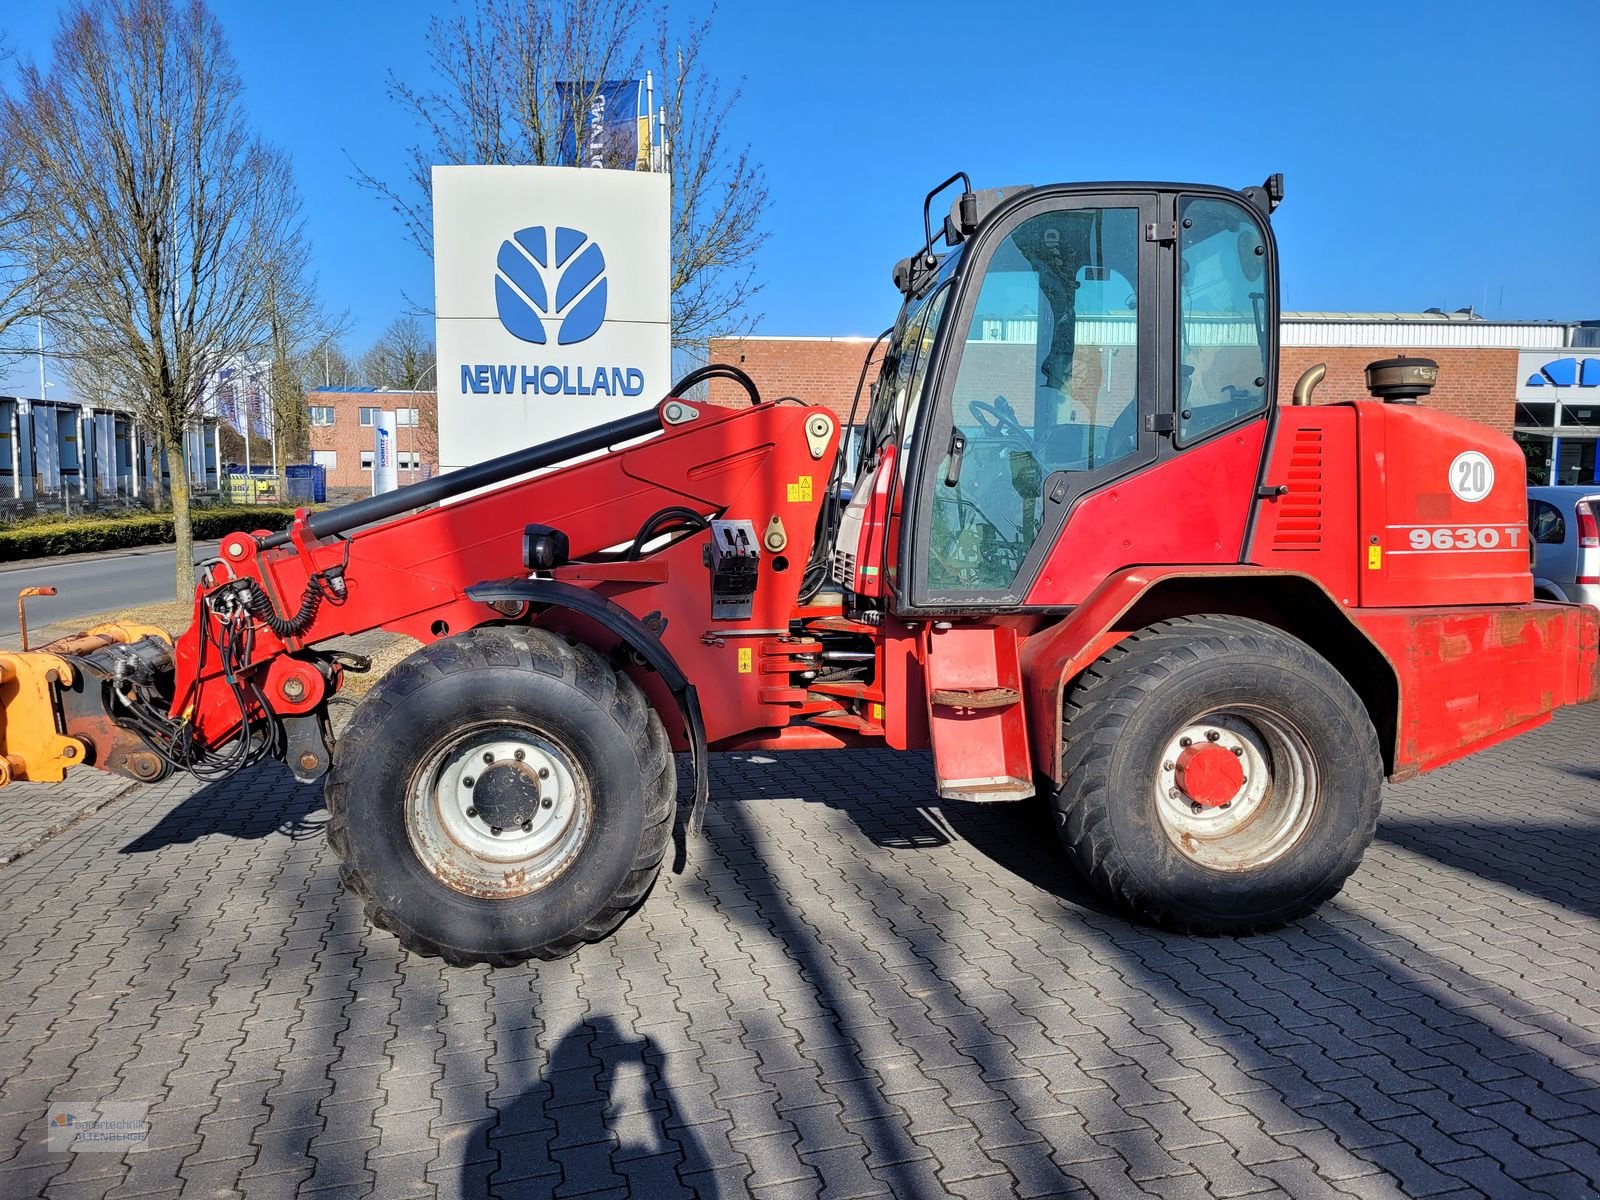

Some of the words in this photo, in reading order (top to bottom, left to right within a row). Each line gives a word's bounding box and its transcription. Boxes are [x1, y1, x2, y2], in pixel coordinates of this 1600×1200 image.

[461, 364, 516, 395] NEW
[521, 365, 645, 397] HOLLAND
[1458, 461, 1486, 493] 20
[1408, 528, 1500, 550] 9630
[1504, 528, 1521, 548] T
